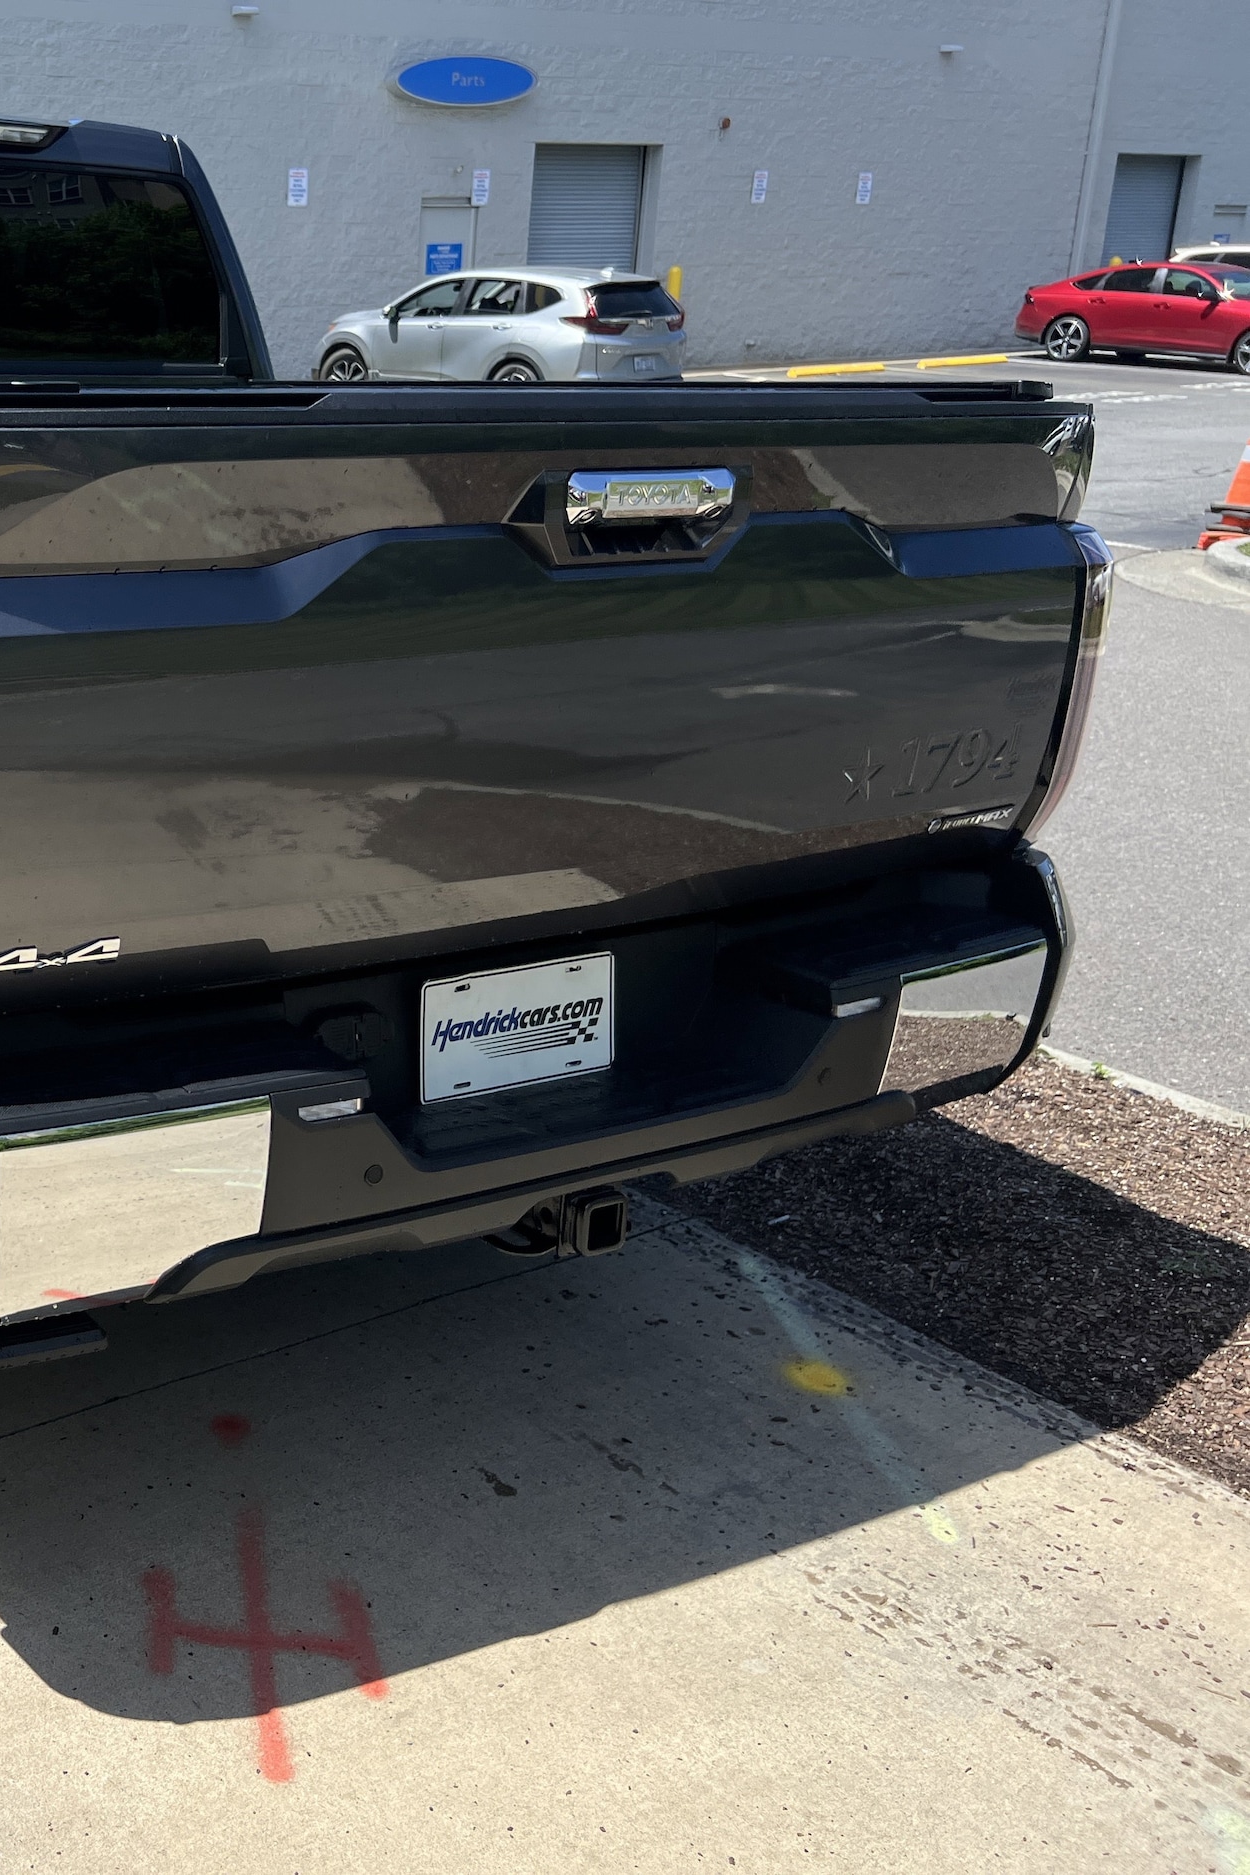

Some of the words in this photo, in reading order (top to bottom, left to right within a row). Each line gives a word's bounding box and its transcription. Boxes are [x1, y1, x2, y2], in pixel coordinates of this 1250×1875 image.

[451, 71, 485, 87] Parts
[616, 483, 691, 506] TOYOTA
[891, 720, 1019, 797] 1794
[431, 997, 603, 1052] Hendrickcars.com
